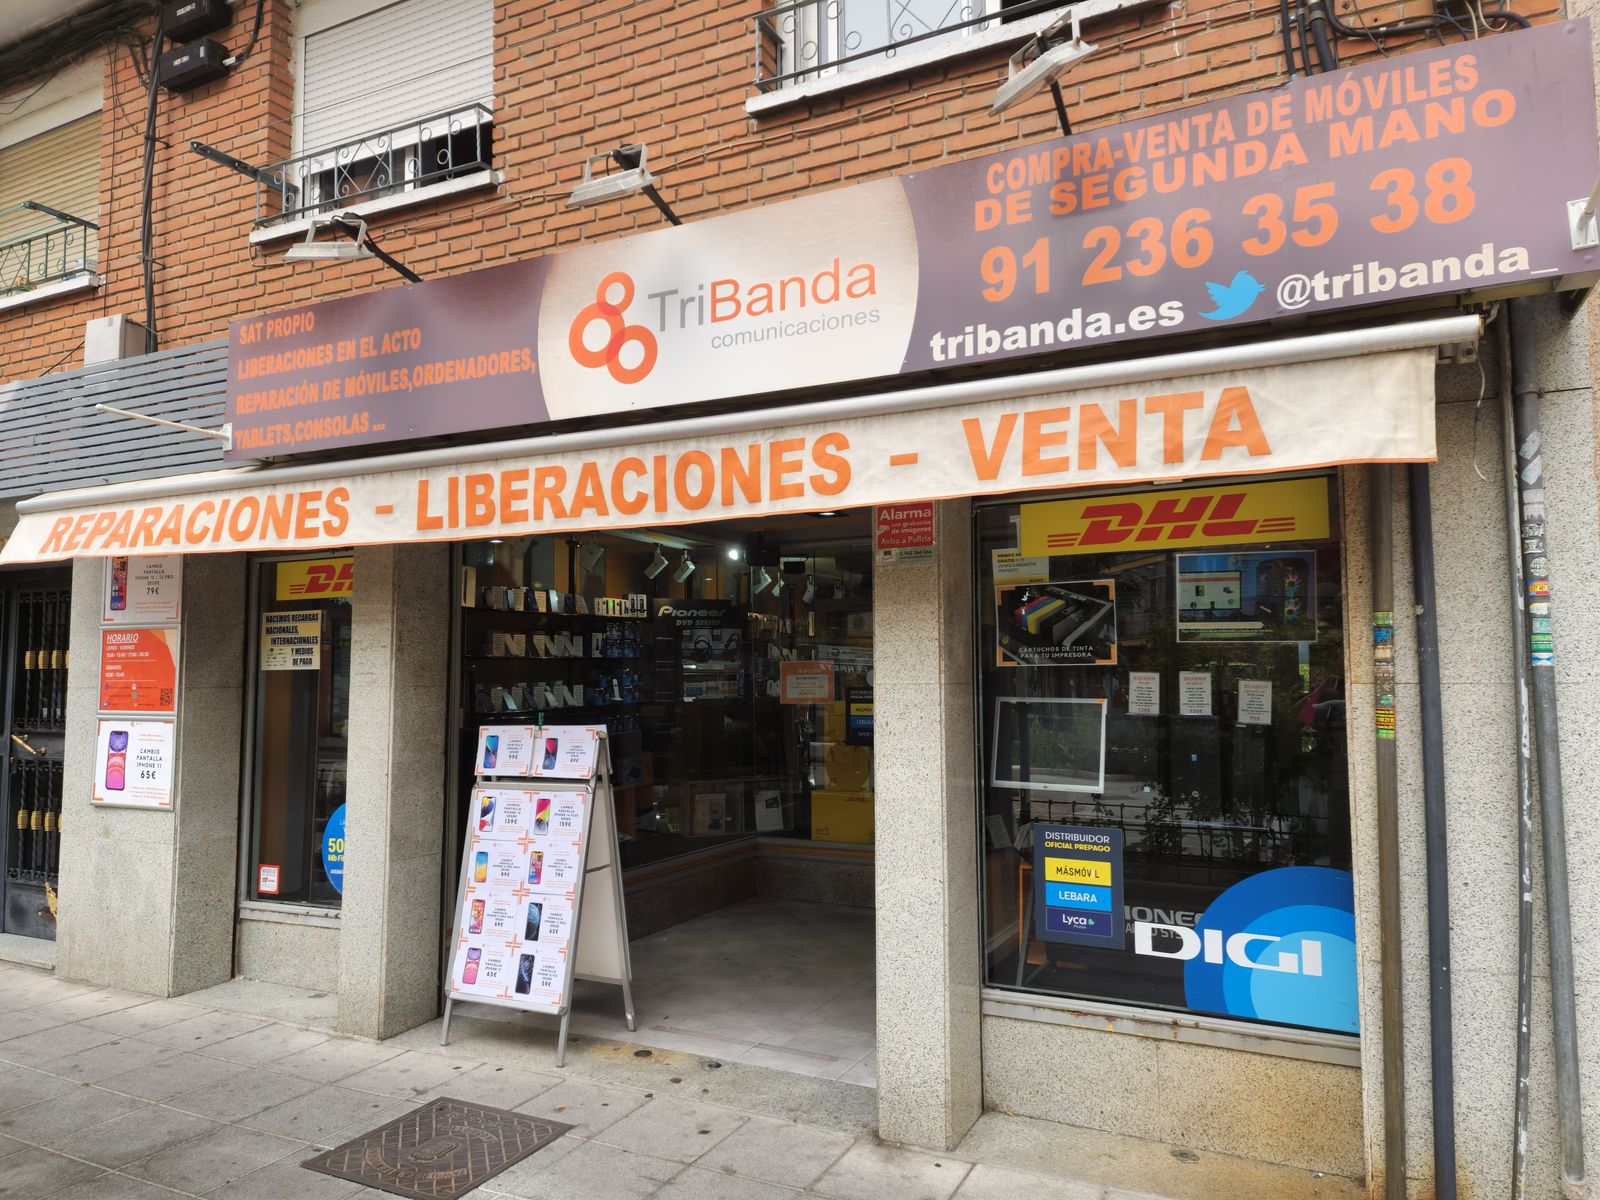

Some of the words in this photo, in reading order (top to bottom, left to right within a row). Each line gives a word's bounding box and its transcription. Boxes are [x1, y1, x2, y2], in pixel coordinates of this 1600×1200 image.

[987, 110, 1235, 195] COMPRA-VENTA
[1248, 91, 1292, 131] DE
[1305, 54, 1479, 124] MÓVILES
[975, 197, 1033, 231] DE
[1049, 136, 1305, 215] SEGUNDA
[1329, 88, 1516, 158] MANO
[981, 237, 1050, 302] 91
[1081, 207, 1214, 286] 236
[1242, 182, 1338, 255] 35
[1369, 158, 1476, 233] 38
[647, 257, 877, 333] TriBanda
[930, 300, 1185, 362] tribanda.es
[1277, 243, 1558, 310] @tribanda_
[240, 322, 262, 345] SAT
[266, 311, 315, 338] PROPIO
[711, 309, 880, 349] comunicaciones
[238, 344, 333, 379] LIBERACIONES
[337, 341, 355, 361] EN
[360, 336, 377, 358] EL
[381, 327, 421, 355] ACTO
[236, 381, 318, 415] REPARACIÓN
[323, 378, 341, 400] DE
[39, 487, 350, 553] REPARACIONES
[416, 432, 852, 529] LIBERACIONES
[962, 387, 1271, 481] VENTA
[880, 508, 931, 520] Alarma
[1078, 493, 1259, 546] DHL
[266, 614, 290, 623] HACEMOS
[292, 613, 319, 622] RECARGAS
[658, 605, 728, 617] Pioneer
[107, 634, 138, 642] HORARIO
[271, 636, 318, 645] INTERNACIONALES
[140, 771, 156, 779] 65€
[1045, 831, 1110, 844] DISTRIBUIDOR
[1045, 841, 1073, 850] OFICIAL
[1075, 843, 1111, 853] PREPAGO
[1059, 891, 1097, 903] LEBARA
[1062, 914, 1087, 926] Lyca
[1135, 921, 1322, 977] DIGI
